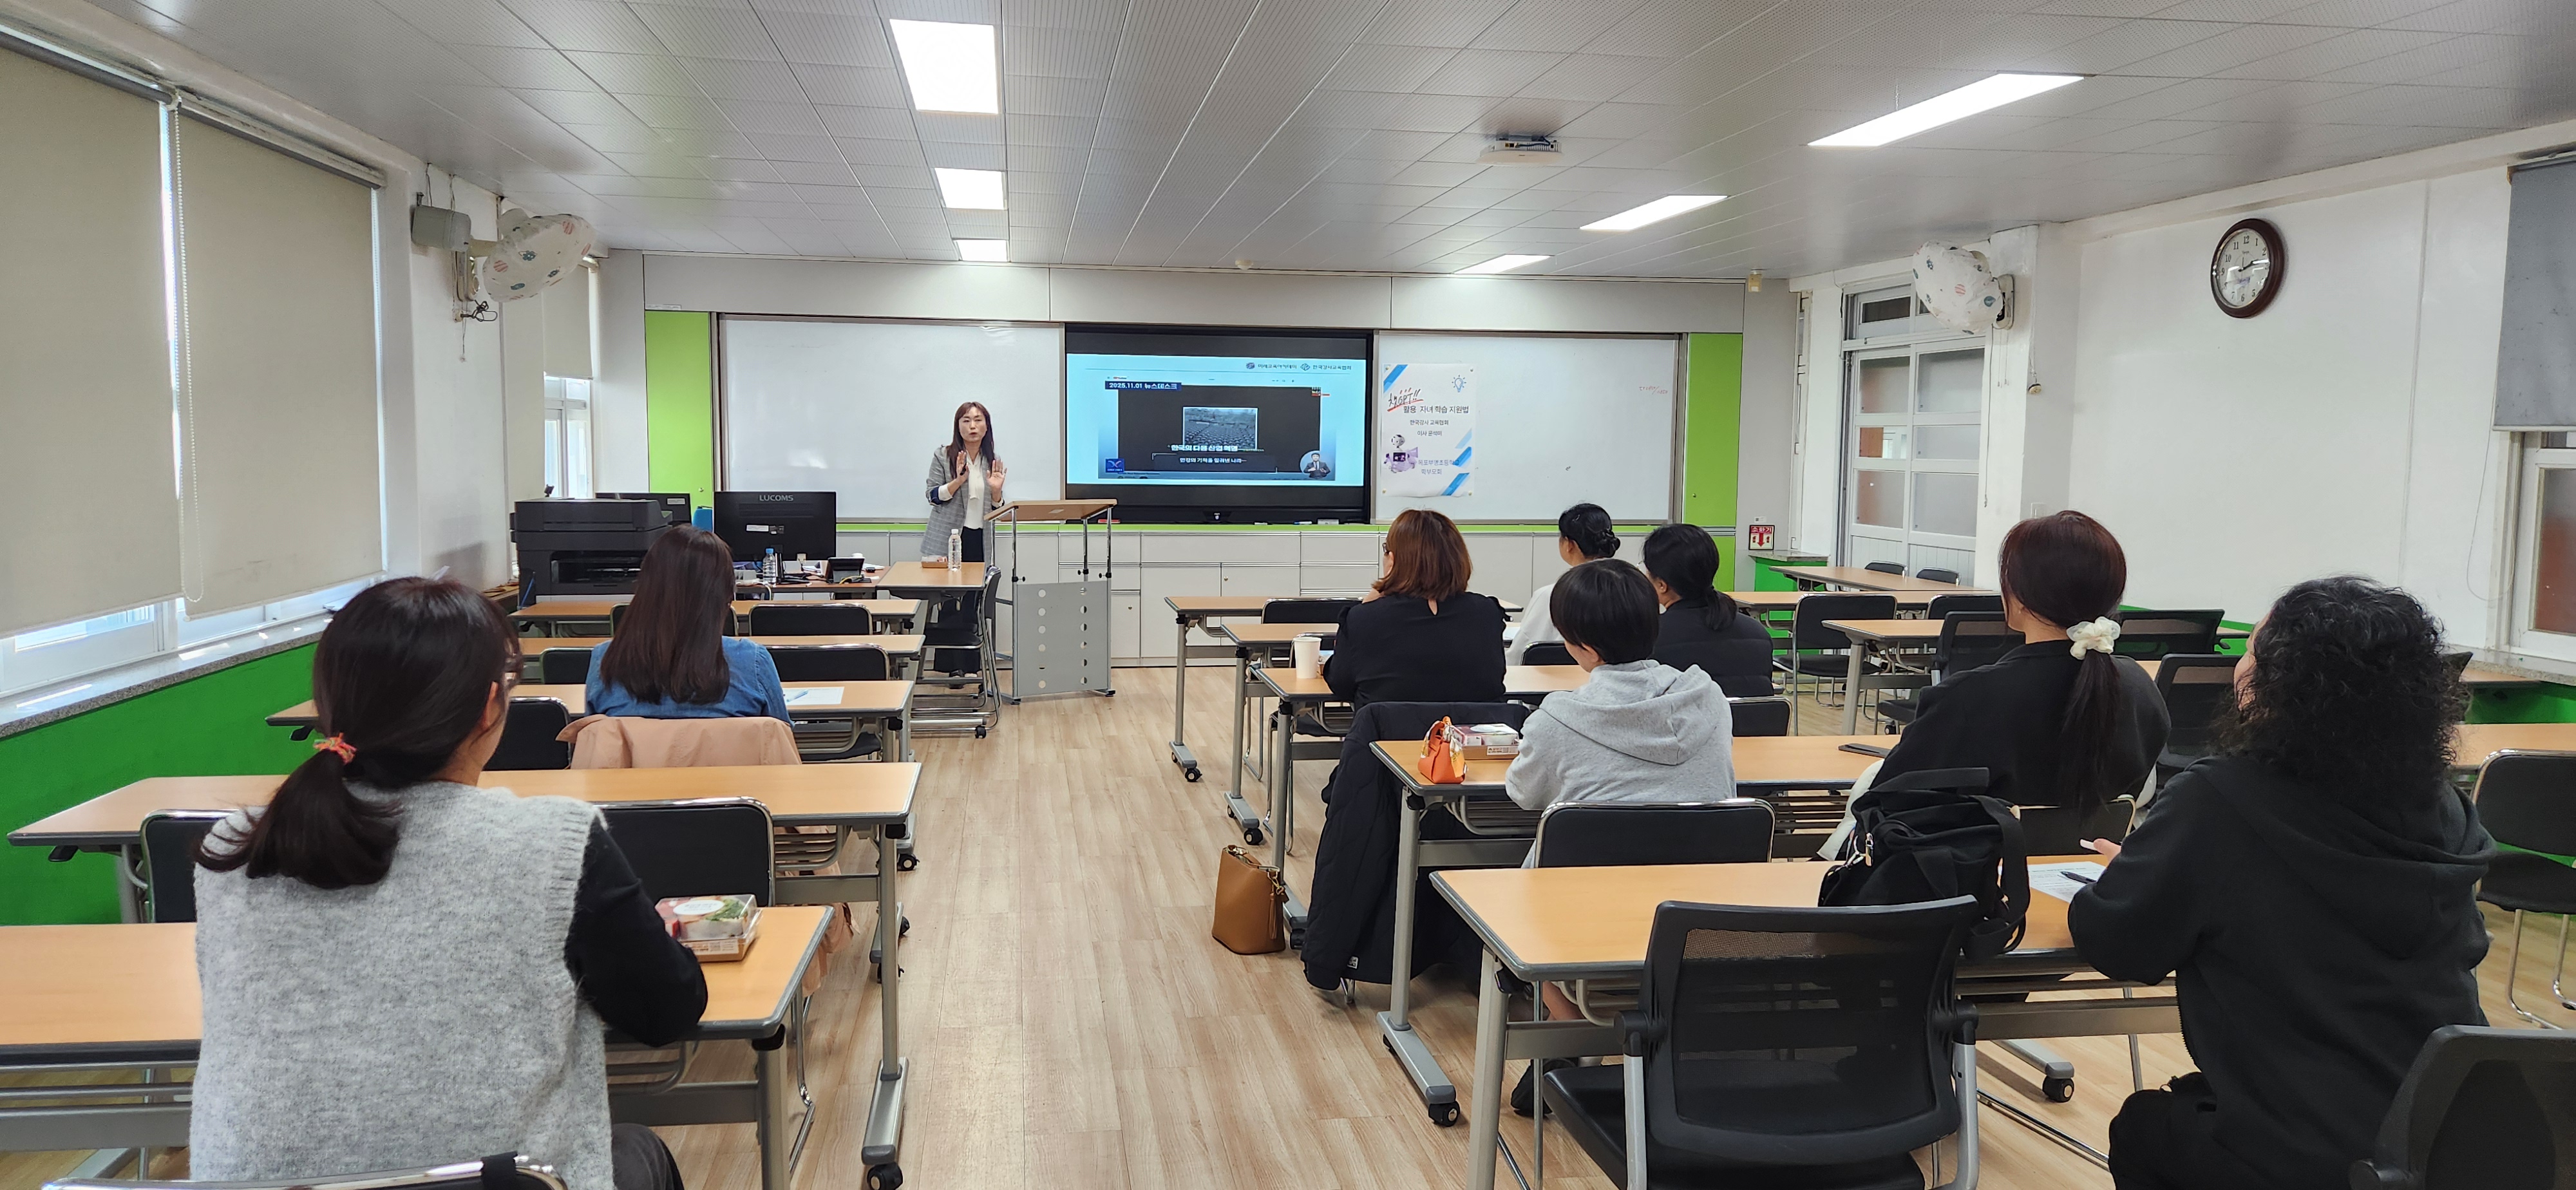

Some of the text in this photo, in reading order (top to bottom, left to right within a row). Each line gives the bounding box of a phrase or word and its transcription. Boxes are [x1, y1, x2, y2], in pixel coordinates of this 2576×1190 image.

[2243, 235, 2249, 244] 12
[2255, 238, 2259, 246] 1
[2233, 241, 2239, 250] 11
[2262, 247, 2266, 256] 2
[2225, 254, 2231, 263] 10
[2221, 267, 2225, 276] 9
[2251, 288, 2256, 297] 5
[2241, 293, 2245, 302] 6
